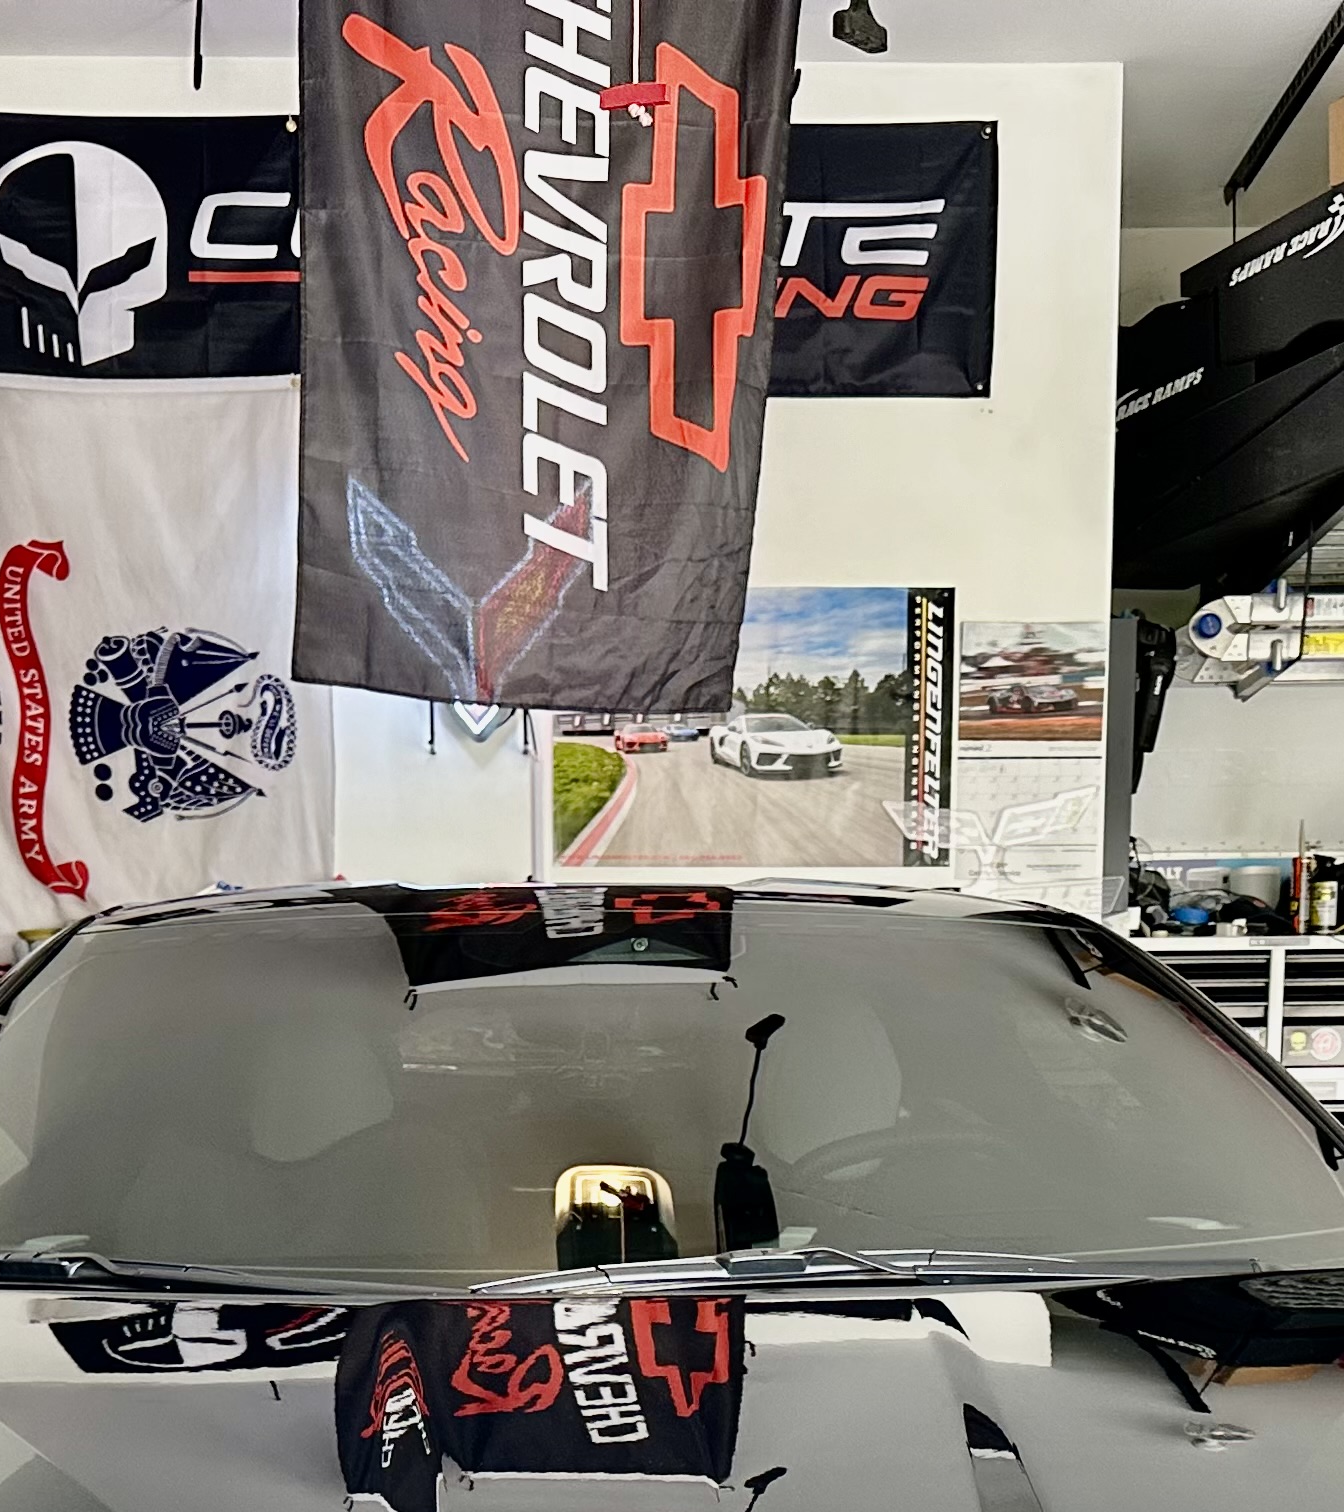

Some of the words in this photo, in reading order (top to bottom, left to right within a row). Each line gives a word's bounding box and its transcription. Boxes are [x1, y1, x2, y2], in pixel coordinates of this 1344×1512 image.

[342, 12, 520, 463] Racing
[1229, 242, 1287, 287] RAMPS
[522, 0, 612, 591] HEVROLET
[1152, 367, 1205, 406] RAMPS
[2, 565, 31, 657] UNITED
[18, 667, 46, 768] STATES
[922, 601, 945, 860] LINGENFELTER
[18, 776, 46, 864] ARMY
